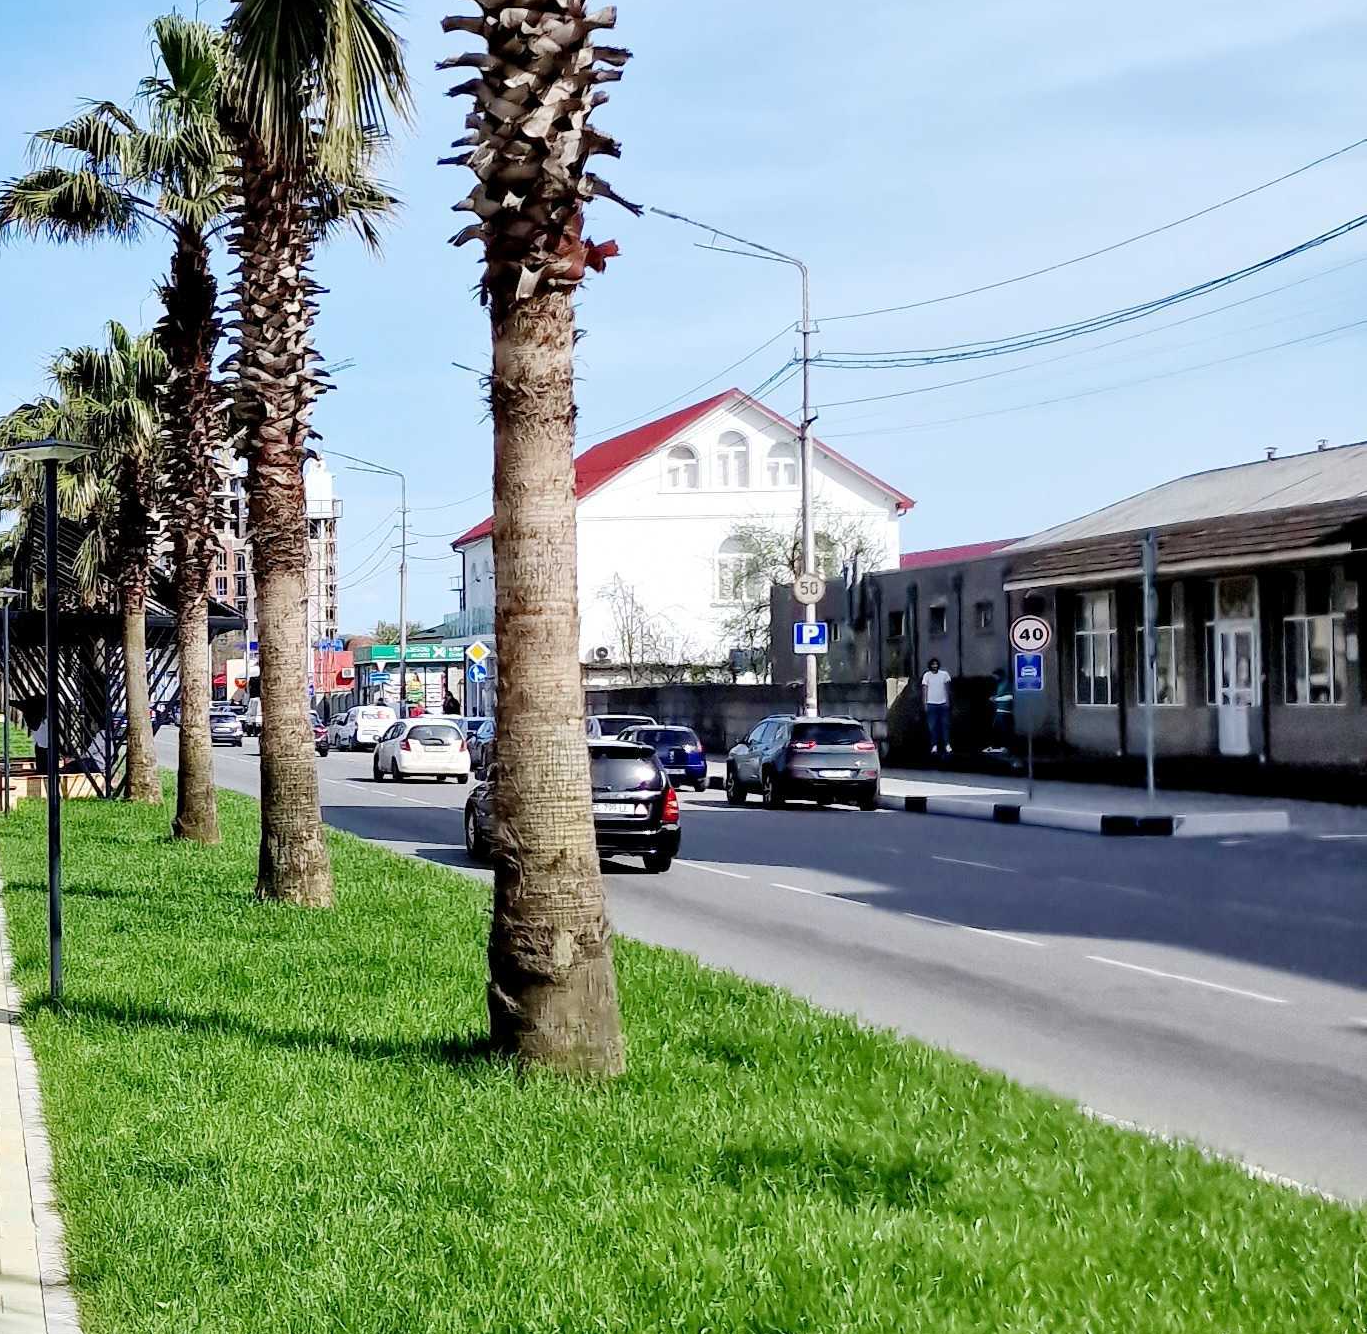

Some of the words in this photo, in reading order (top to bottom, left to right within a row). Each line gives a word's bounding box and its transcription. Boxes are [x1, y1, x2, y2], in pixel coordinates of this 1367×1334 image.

[800, 581, 819, 596] 50
[802, 624, 821, 644] P
[1019, 627, 1044, 641] 40
